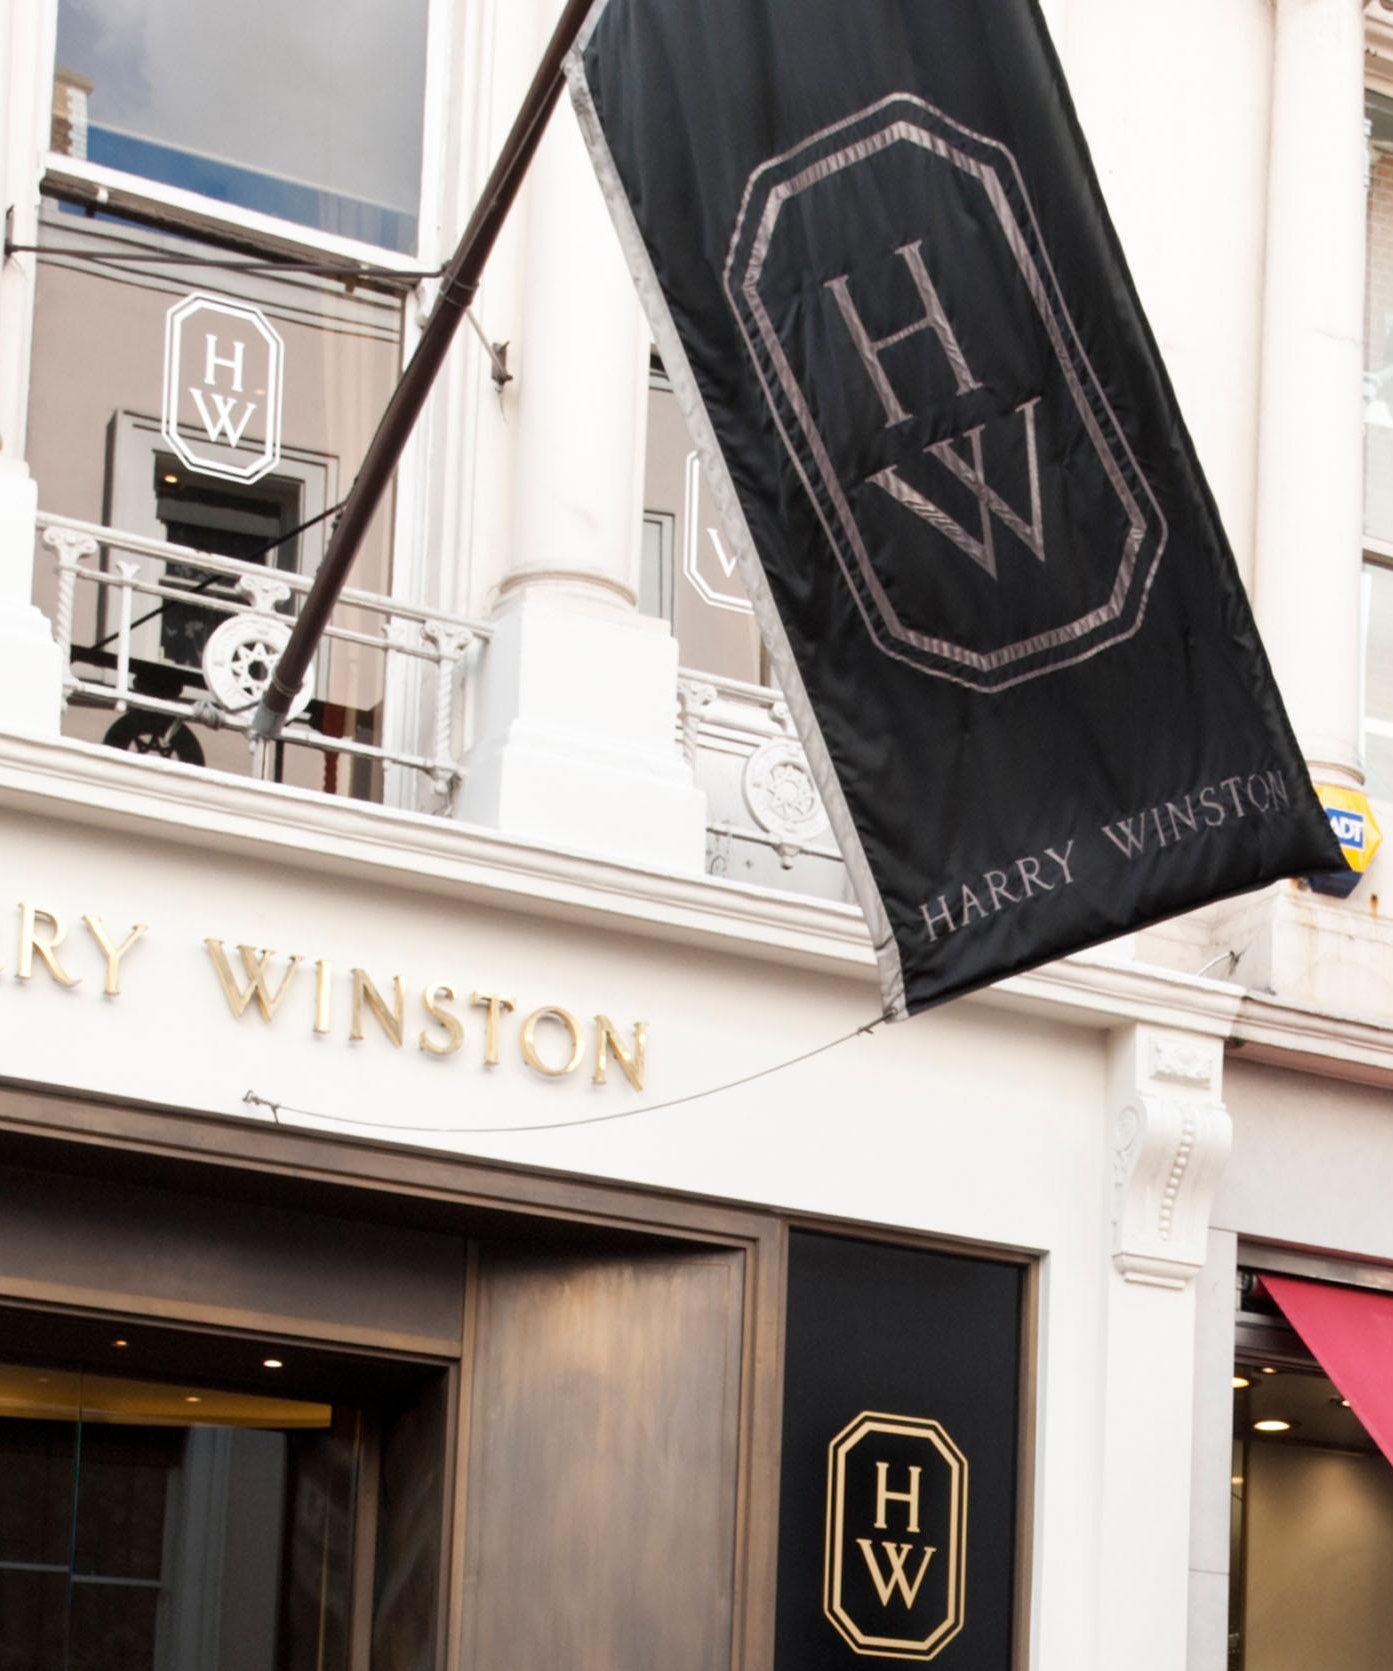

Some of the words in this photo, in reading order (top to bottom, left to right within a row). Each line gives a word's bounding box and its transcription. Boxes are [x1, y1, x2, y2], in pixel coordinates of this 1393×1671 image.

[918, 839, 1075, 943] HARRY
[1100, 770, 1291, 861] WINSTON
[203, 935, 650, 1094] WINSTON
